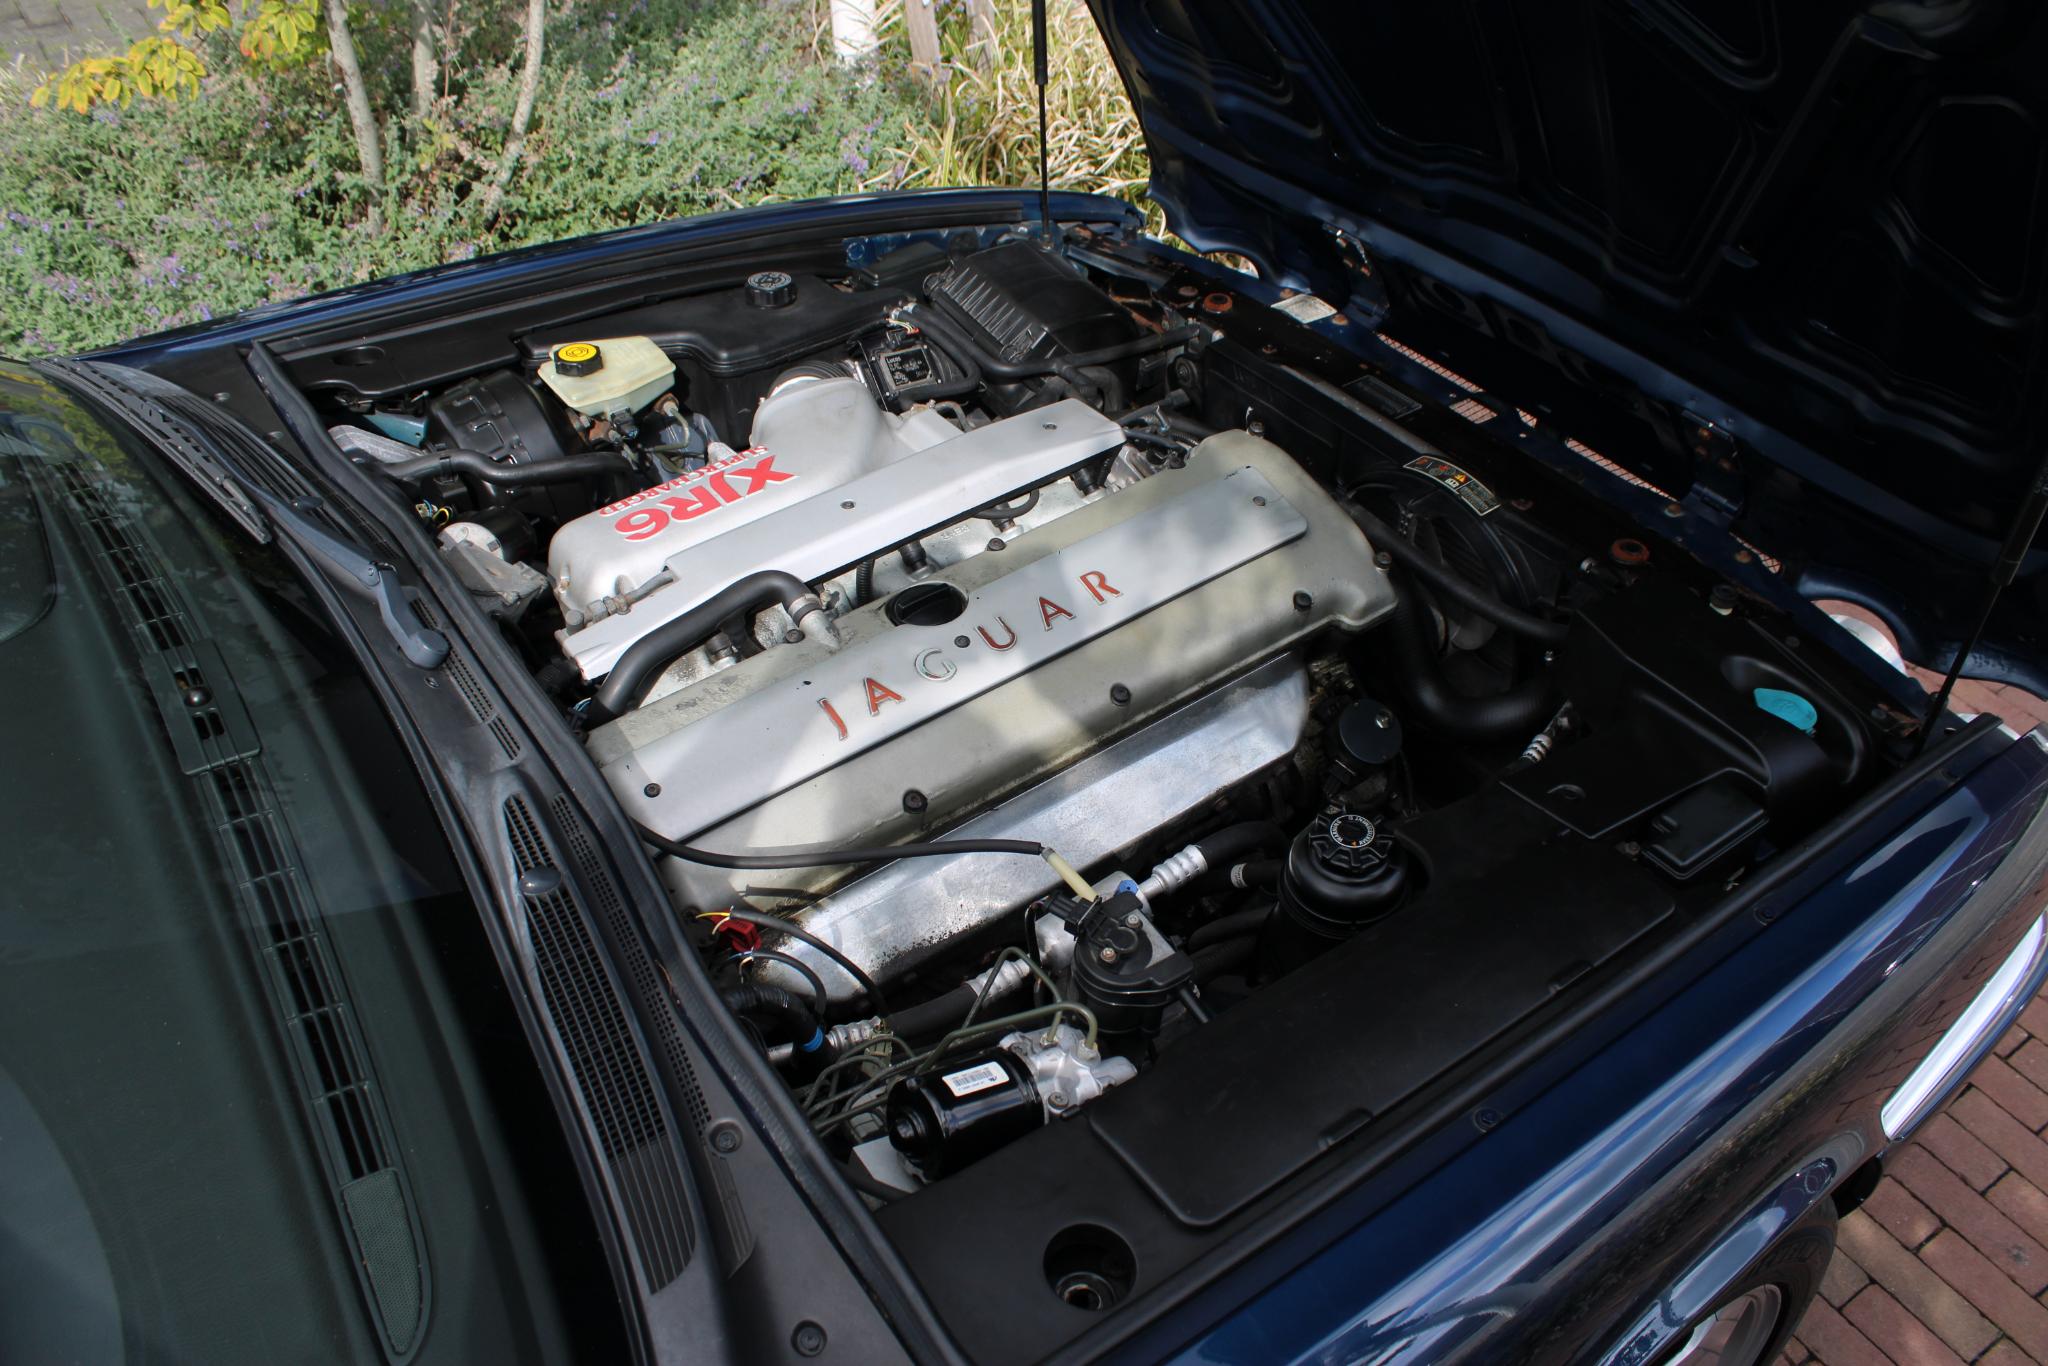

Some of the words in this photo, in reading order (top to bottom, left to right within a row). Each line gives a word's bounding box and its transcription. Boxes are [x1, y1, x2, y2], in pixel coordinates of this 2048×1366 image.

[599, 445, 769, 518] SUPERCHARGED
[614, 455, 800, 542] XJR6
[817, 570, 1123, 740] JAGUAR
